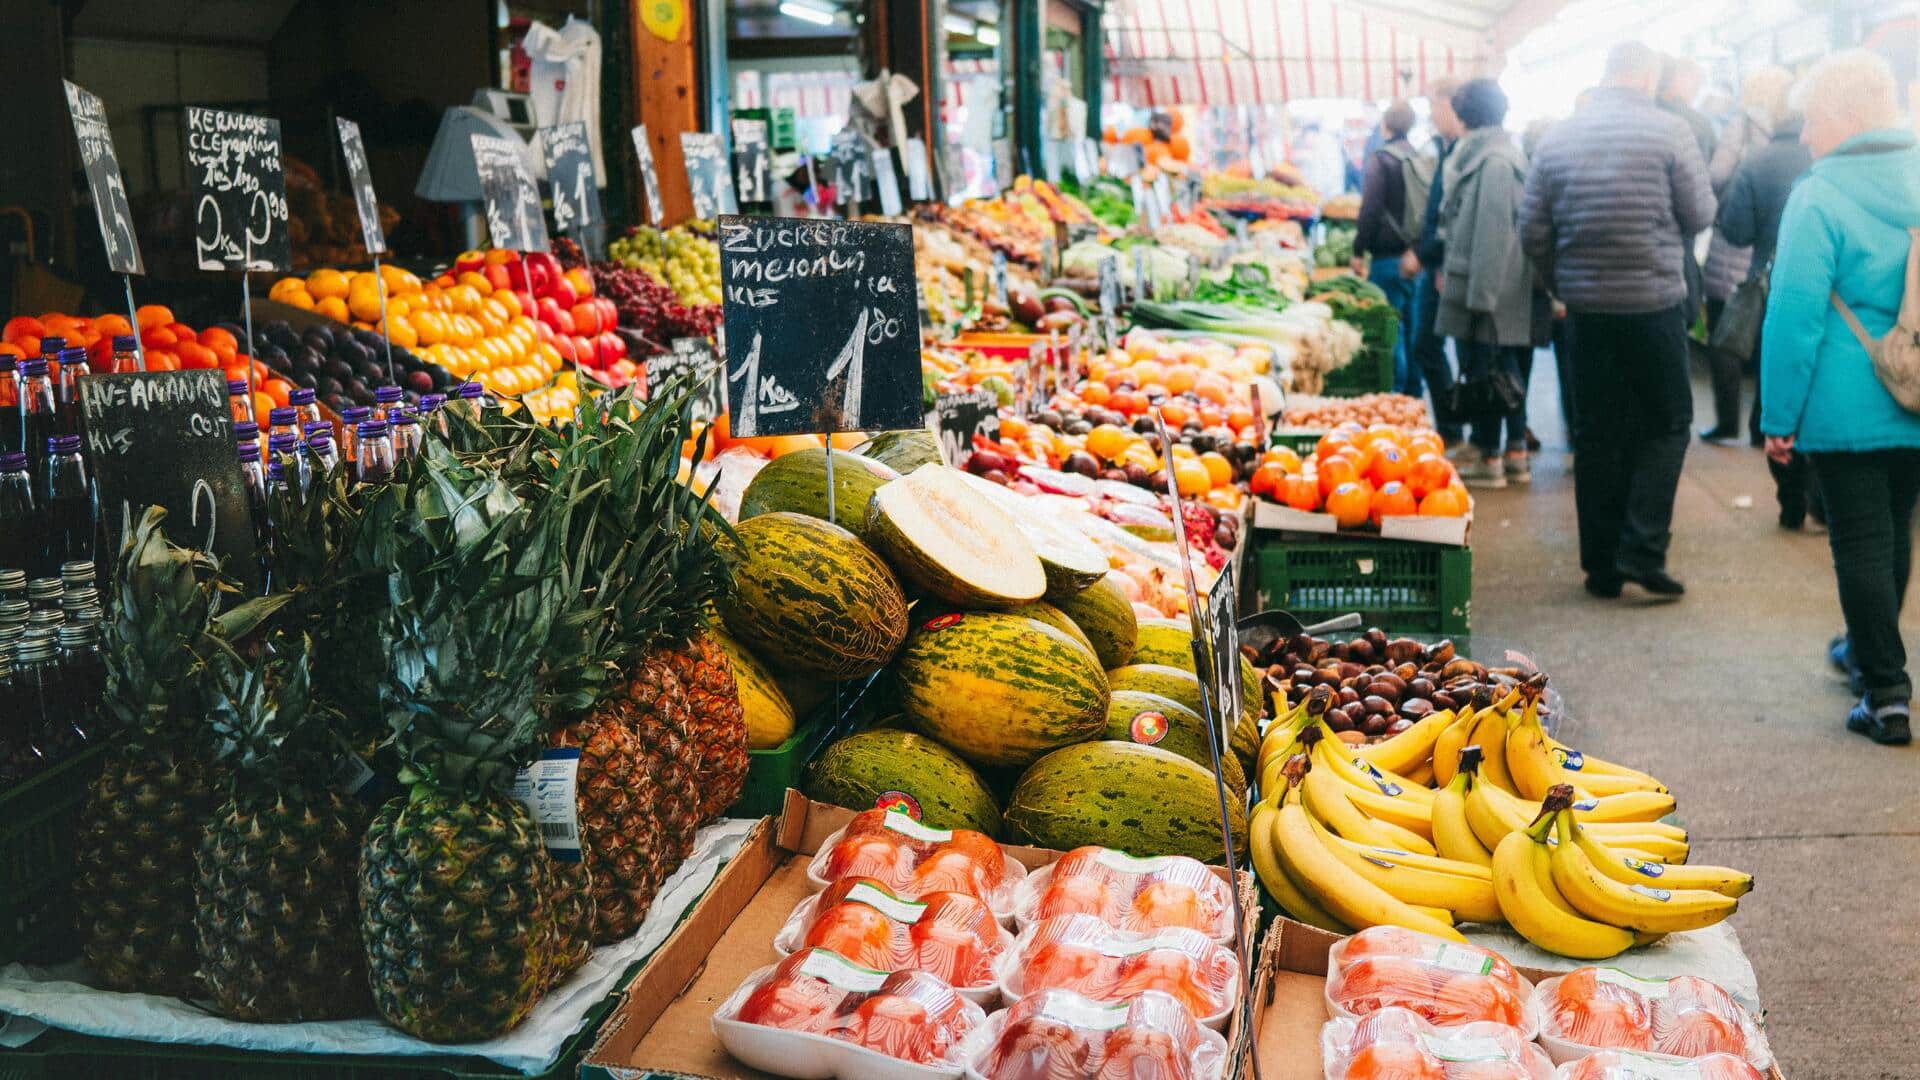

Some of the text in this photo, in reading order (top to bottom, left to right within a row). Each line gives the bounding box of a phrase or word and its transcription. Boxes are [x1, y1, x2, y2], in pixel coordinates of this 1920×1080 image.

[196, 194, 225, 271] 2
[245, 189, 274, 272] 2
[720, 223, 850, 253] ZUCKER
[728, 331, 762, 437] 1
[826, 306, 869, 431] 1
